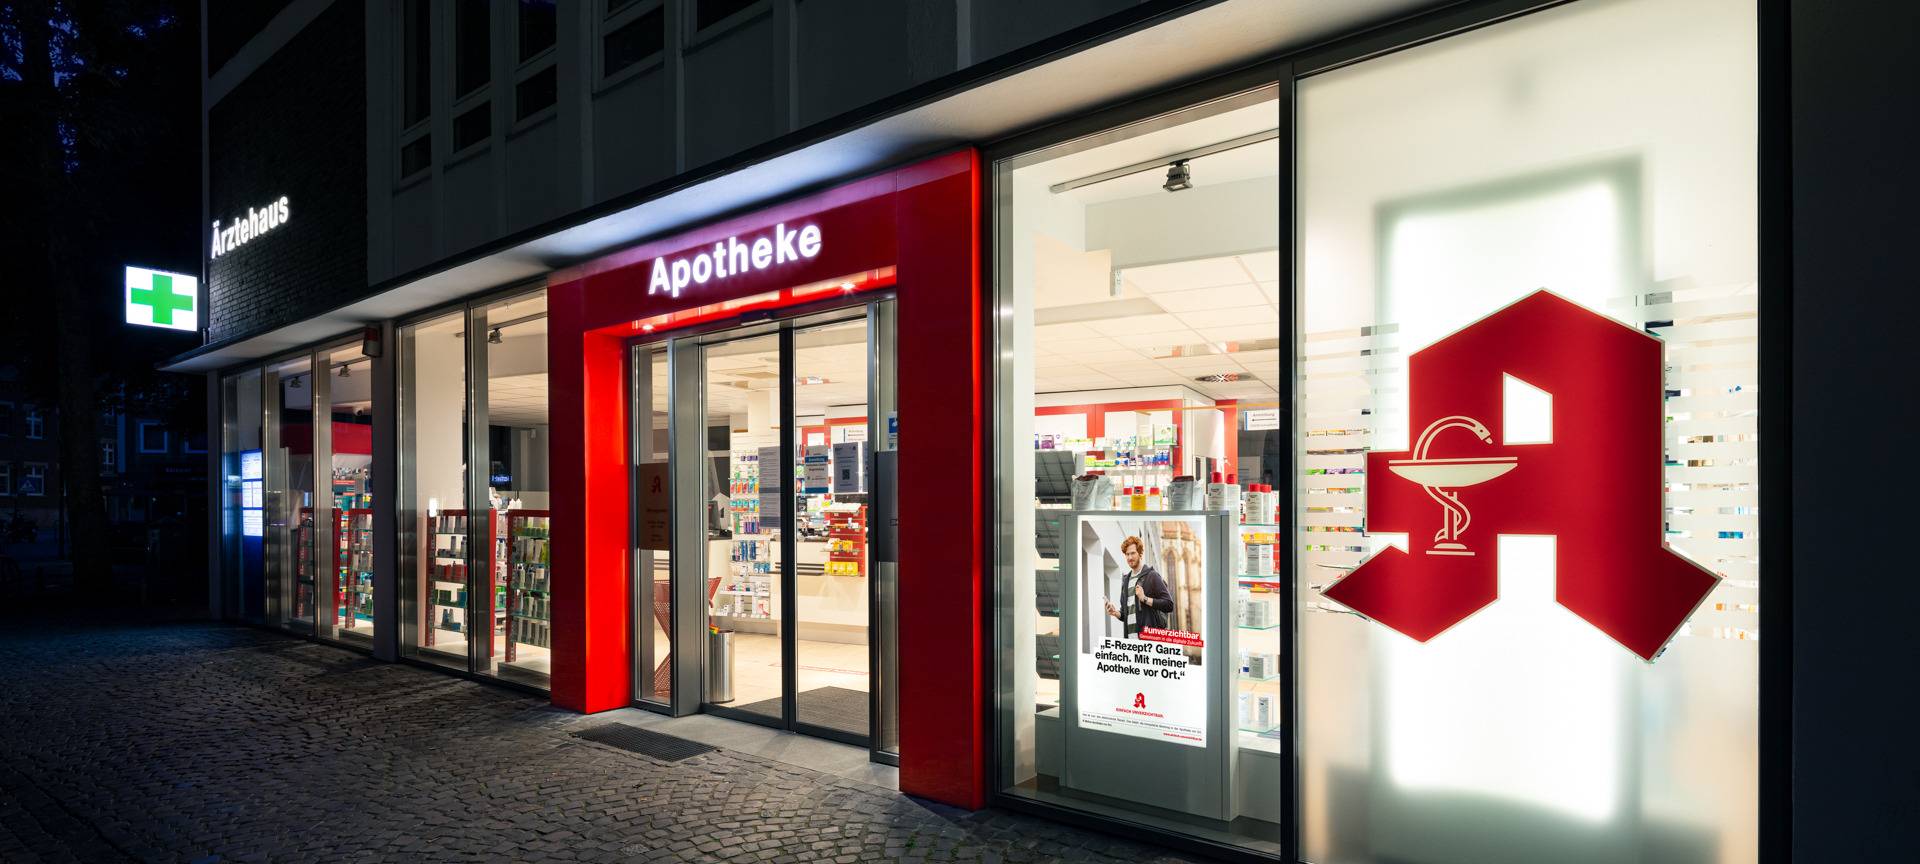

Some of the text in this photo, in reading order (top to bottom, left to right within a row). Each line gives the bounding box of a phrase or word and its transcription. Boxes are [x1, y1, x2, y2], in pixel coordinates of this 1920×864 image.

[211, 195, 289, 260] Ärztehaus
[648, 222, 822, 298] Apotheke
[1143, 626, 1200, 640] #unverzichtbar
[1100, 639, 1181, 656] „E-Rezept? Ganz
[1095, 650, 1187, 668] einfach. Mit meiner
[1096, 661, 1140, 675] Apotheke
[1143, 668, 1158, 677] vor
